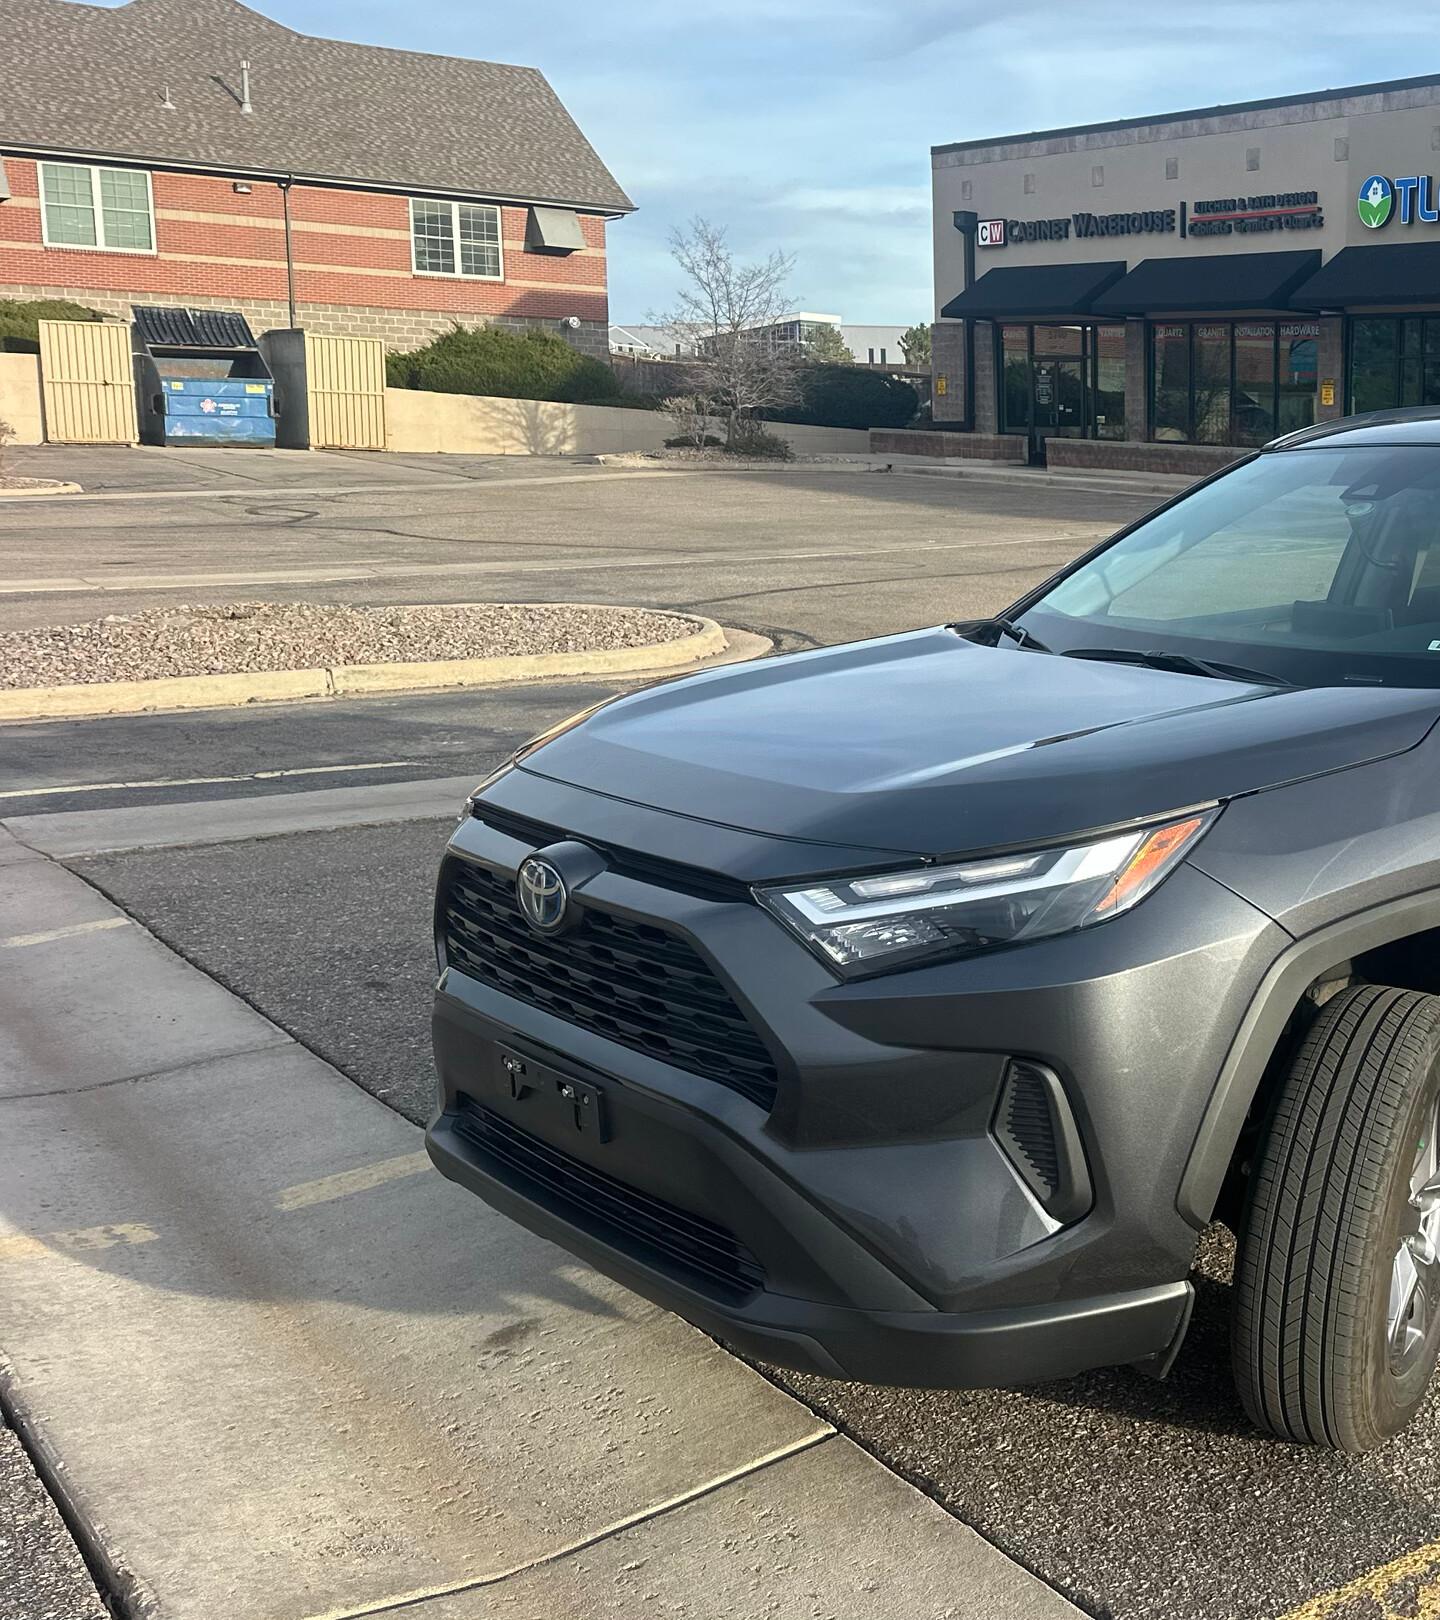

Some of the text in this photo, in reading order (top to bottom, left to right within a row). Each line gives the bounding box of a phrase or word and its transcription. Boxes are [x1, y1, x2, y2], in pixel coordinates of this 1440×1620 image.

[1276, 191, 1318, 206] DESIGN
[980, 223, 1002, 242] CW
[1158, 328, 1184, 337] QUARTZ
[1198, 327, 1226, 337] GRANITE
[1234, 326, 1275, 337] INSTALLATION
[1280, 325, 1320, 337] HARDWARE
